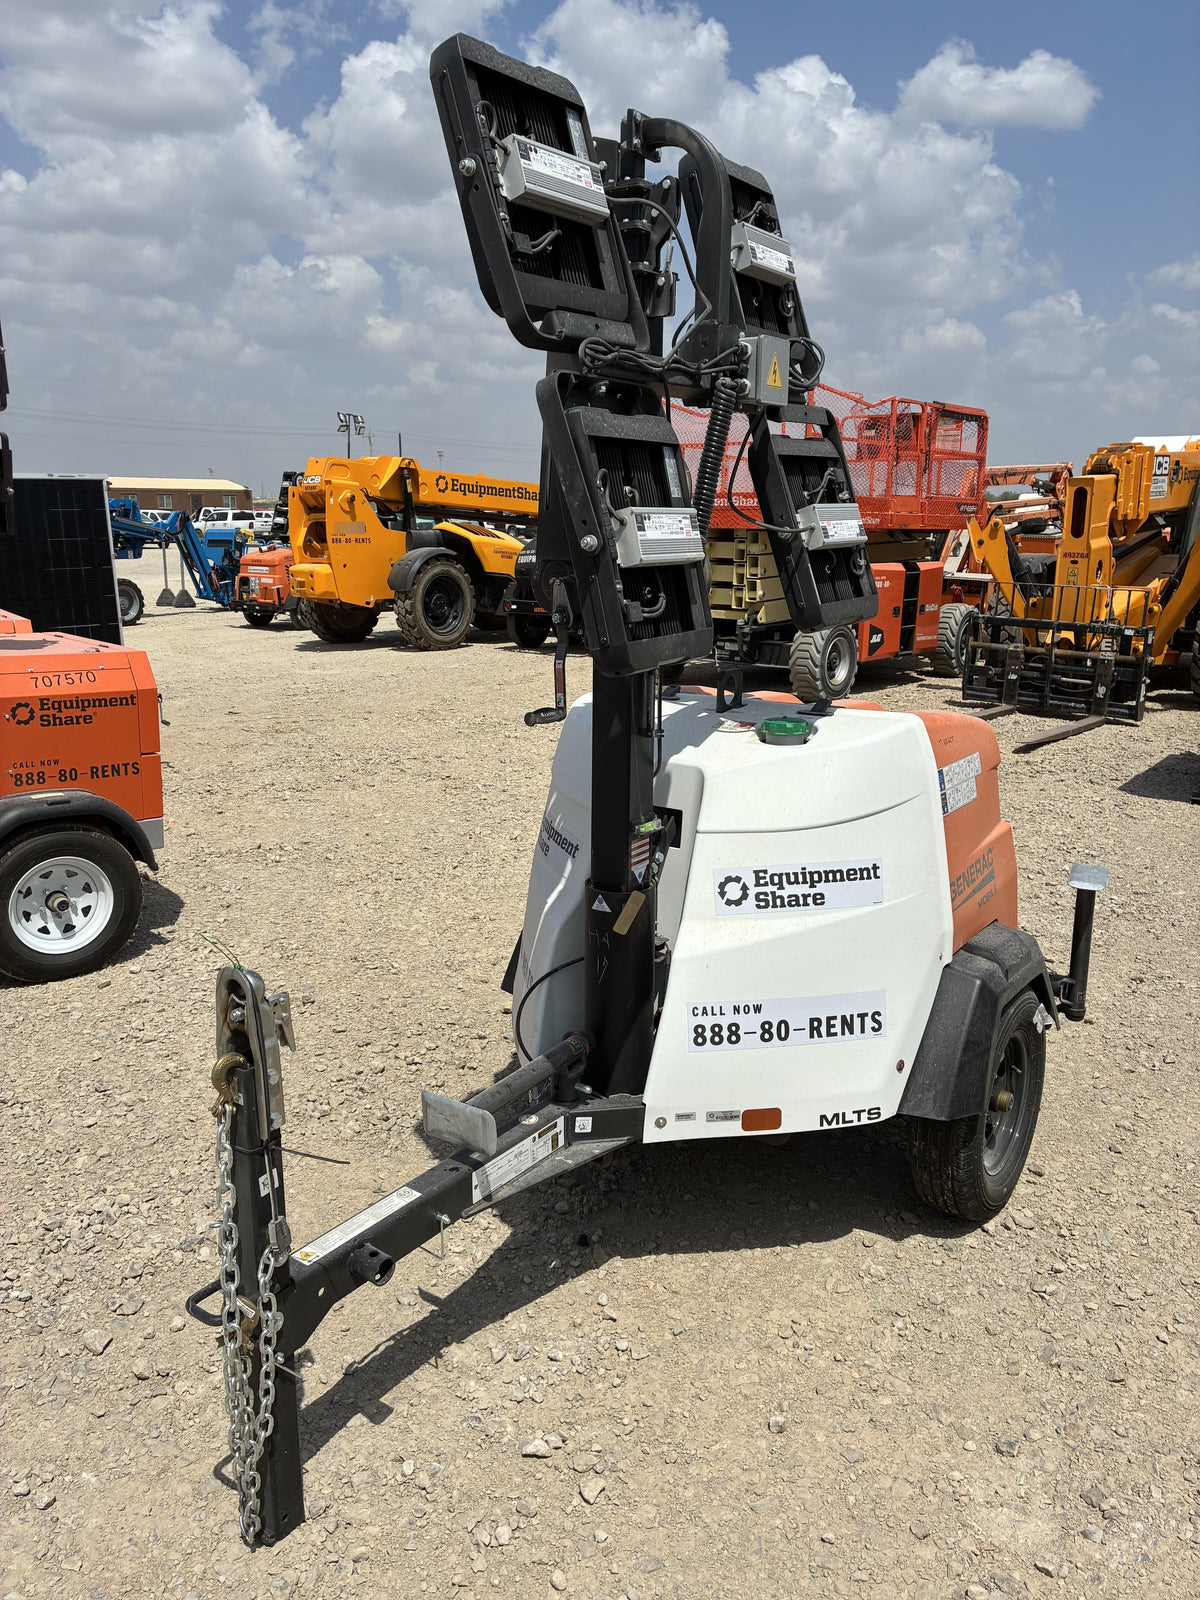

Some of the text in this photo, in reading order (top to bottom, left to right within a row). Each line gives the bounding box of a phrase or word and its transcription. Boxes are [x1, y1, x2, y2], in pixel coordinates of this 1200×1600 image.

[303, 475, 321, 484] JCB
[30, 670, 97, 689] 707570
[38, 694, 137, 713] Equipment
[12, 758, 60, 769] CALL NOW
[13, 762, 140, 787] 888-80-RENTS
[752, 863, 881, 890] Equipment
[949, 848, 995, 903] GENERAC
[754, 891, 826, 910] Share
[977, 884, 998, 911] MOBILE
[691, 1003, 763, 1017] CALL NOW
[692, 1010, 883, 1047] 888-80-RENTS
[818, 1106, 882, 1128] MLTS
